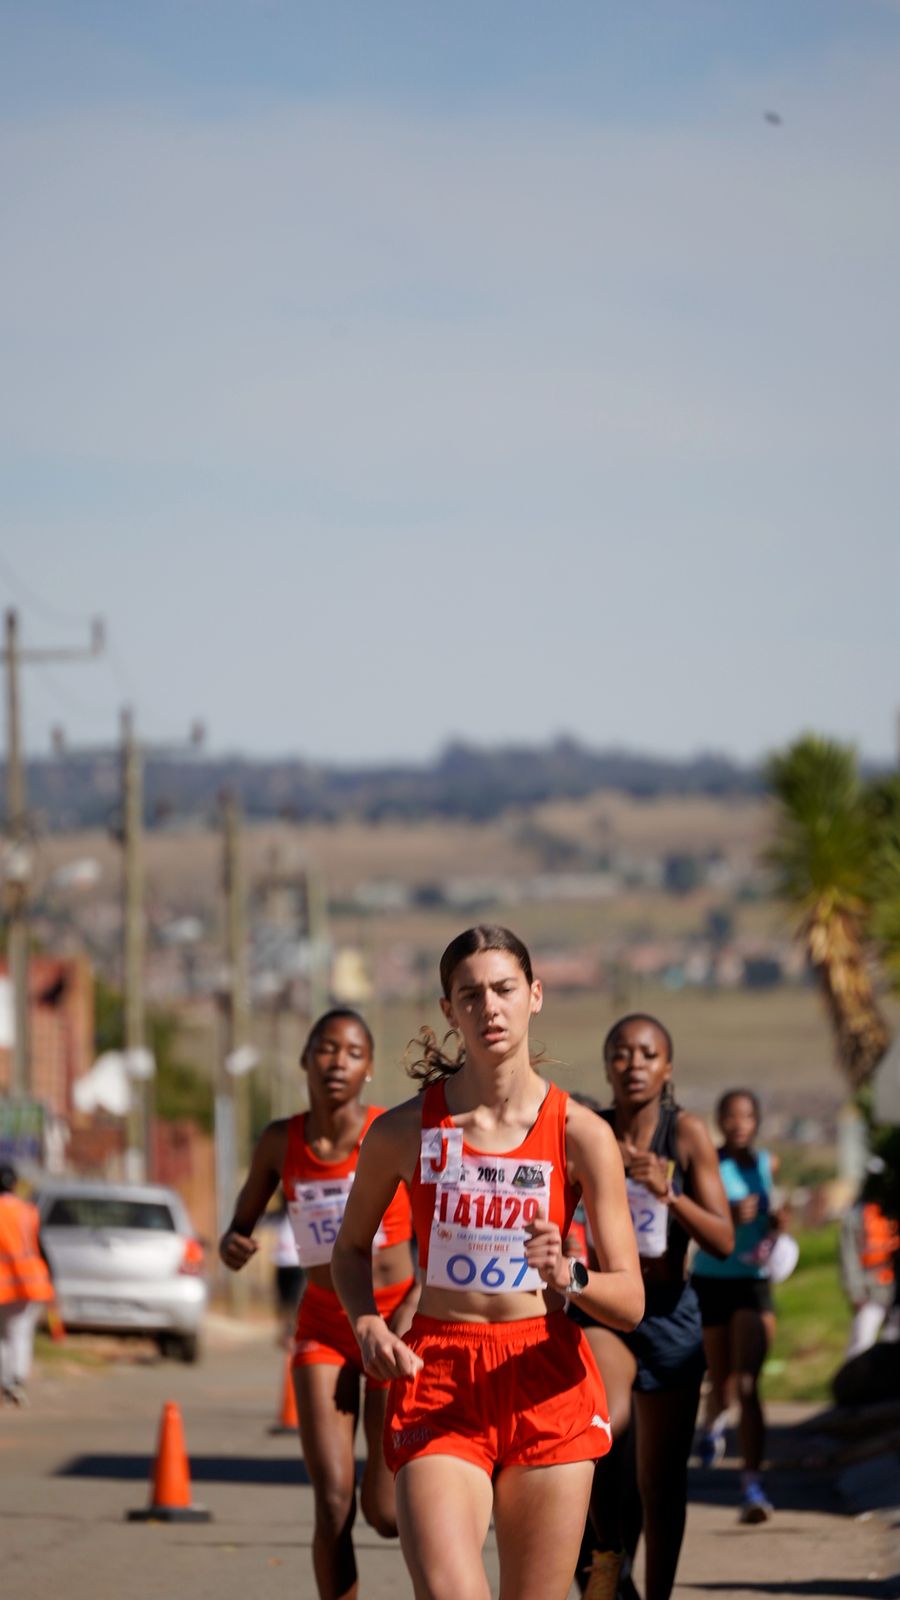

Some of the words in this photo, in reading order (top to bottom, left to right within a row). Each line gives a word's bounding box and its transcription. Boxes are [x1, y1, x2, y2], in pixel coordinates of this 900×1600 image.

[430, 1136, 448, 1173] J
[478, 1166, 505, 1182] 2026
[309, 1216, 343, 1245] 15
[631, 1209, 655, 1232] 2
[468, 1242, 492, 1251] STREET
[447, 1254, 529, 1289] 067
